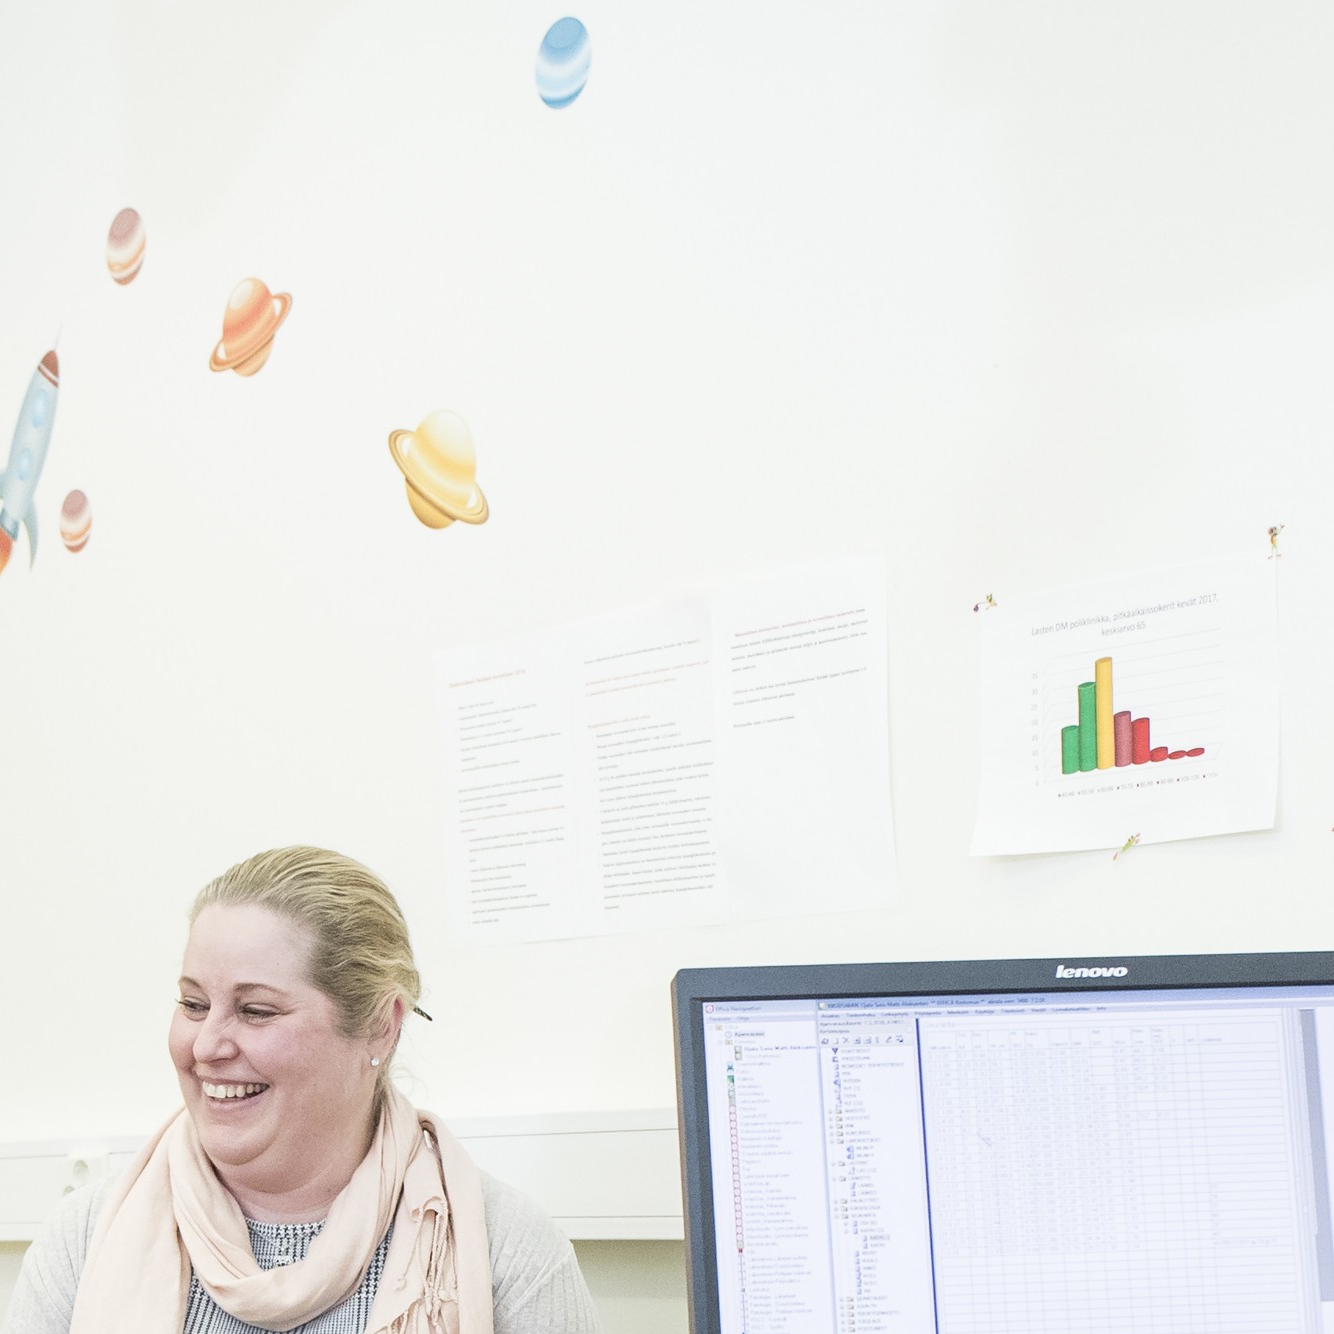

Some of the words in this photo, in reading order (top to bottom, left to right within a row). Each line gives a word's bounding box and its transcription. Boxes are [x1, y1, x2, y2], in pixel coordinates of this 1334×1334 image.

[1031, 624, 1054, 636] Lasten
[1055, 621, 1068, 632] DM
[1101, 623, 1136, 637] keskiarvo
[1136, 620, 1147, 631] 65
[1055, 964, 1129, 979] lenovo
